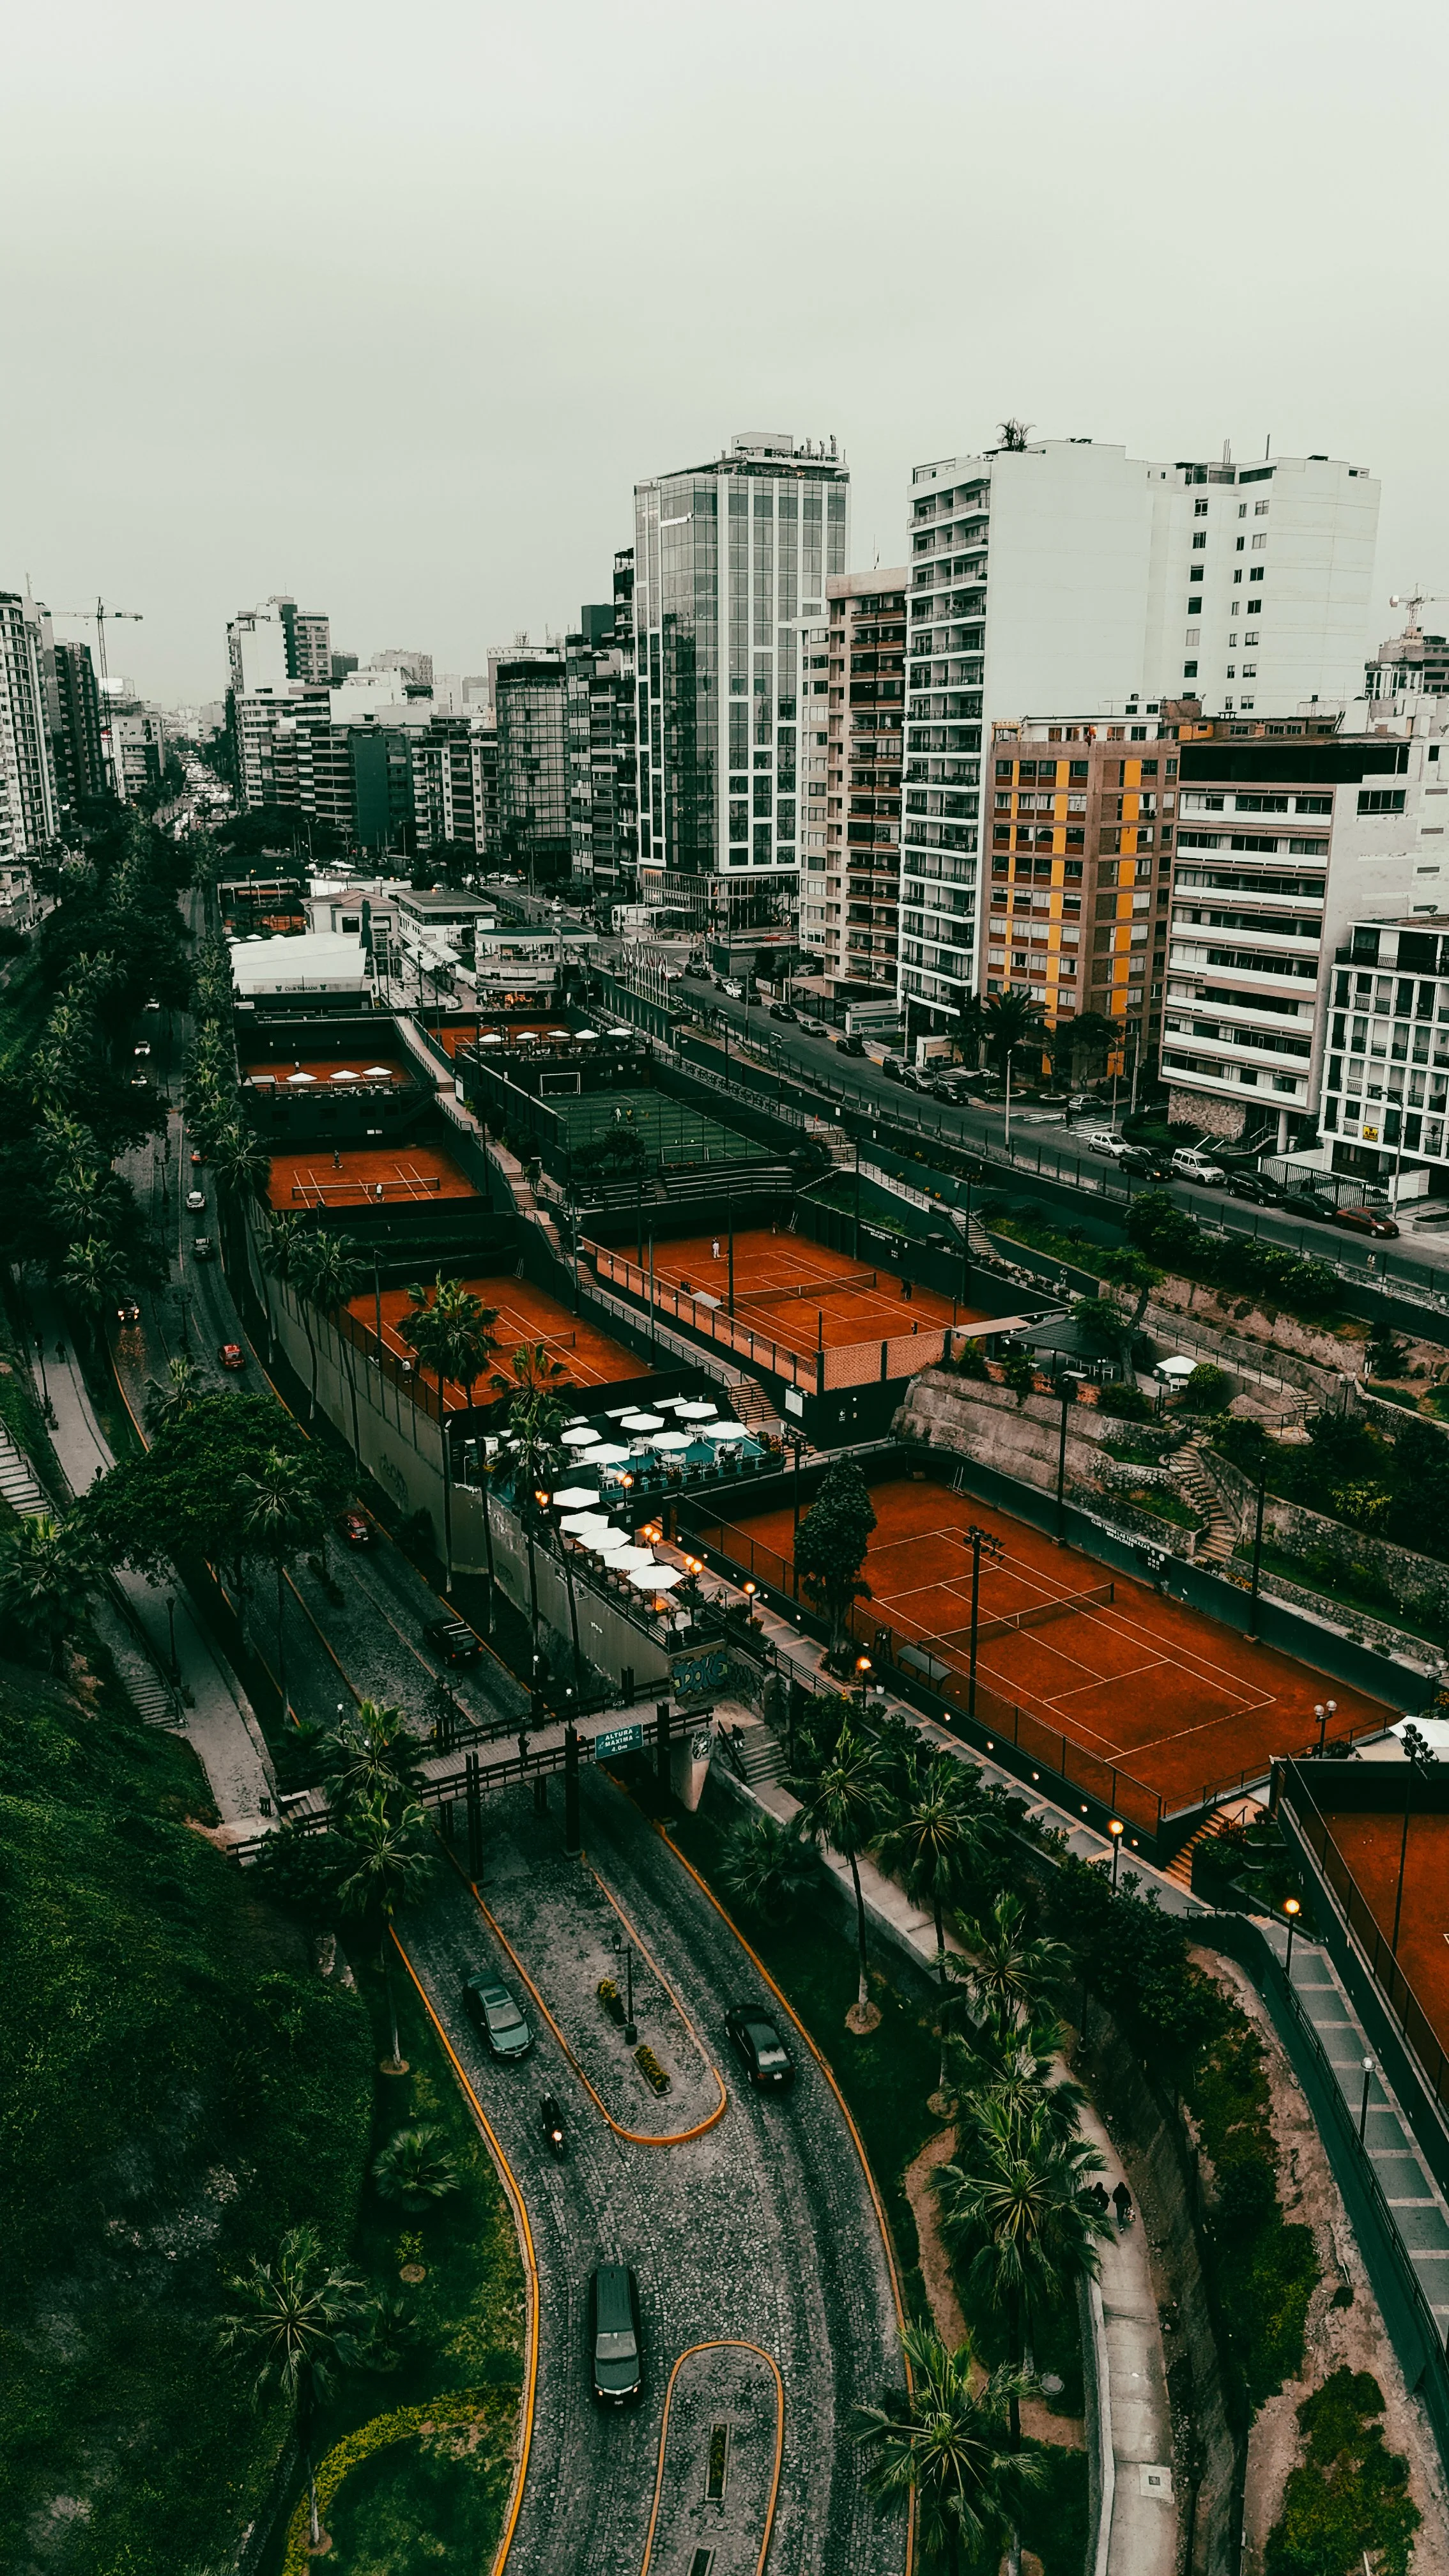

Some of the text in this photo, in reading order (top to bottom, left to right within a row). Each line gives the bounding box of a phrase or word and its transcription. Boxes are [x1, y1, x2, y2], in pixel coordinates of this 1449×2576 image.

[1091, 1518, 1102, 1528] CLUB
[1126, 1535, 1150, 1551] TERRAZAS
[1107, 1531, 1133, 1548] MIRAFLORES
[605, 1728, 632, 1741] ALTURA
[605, 1735, 633, 1747] MAXIMA
